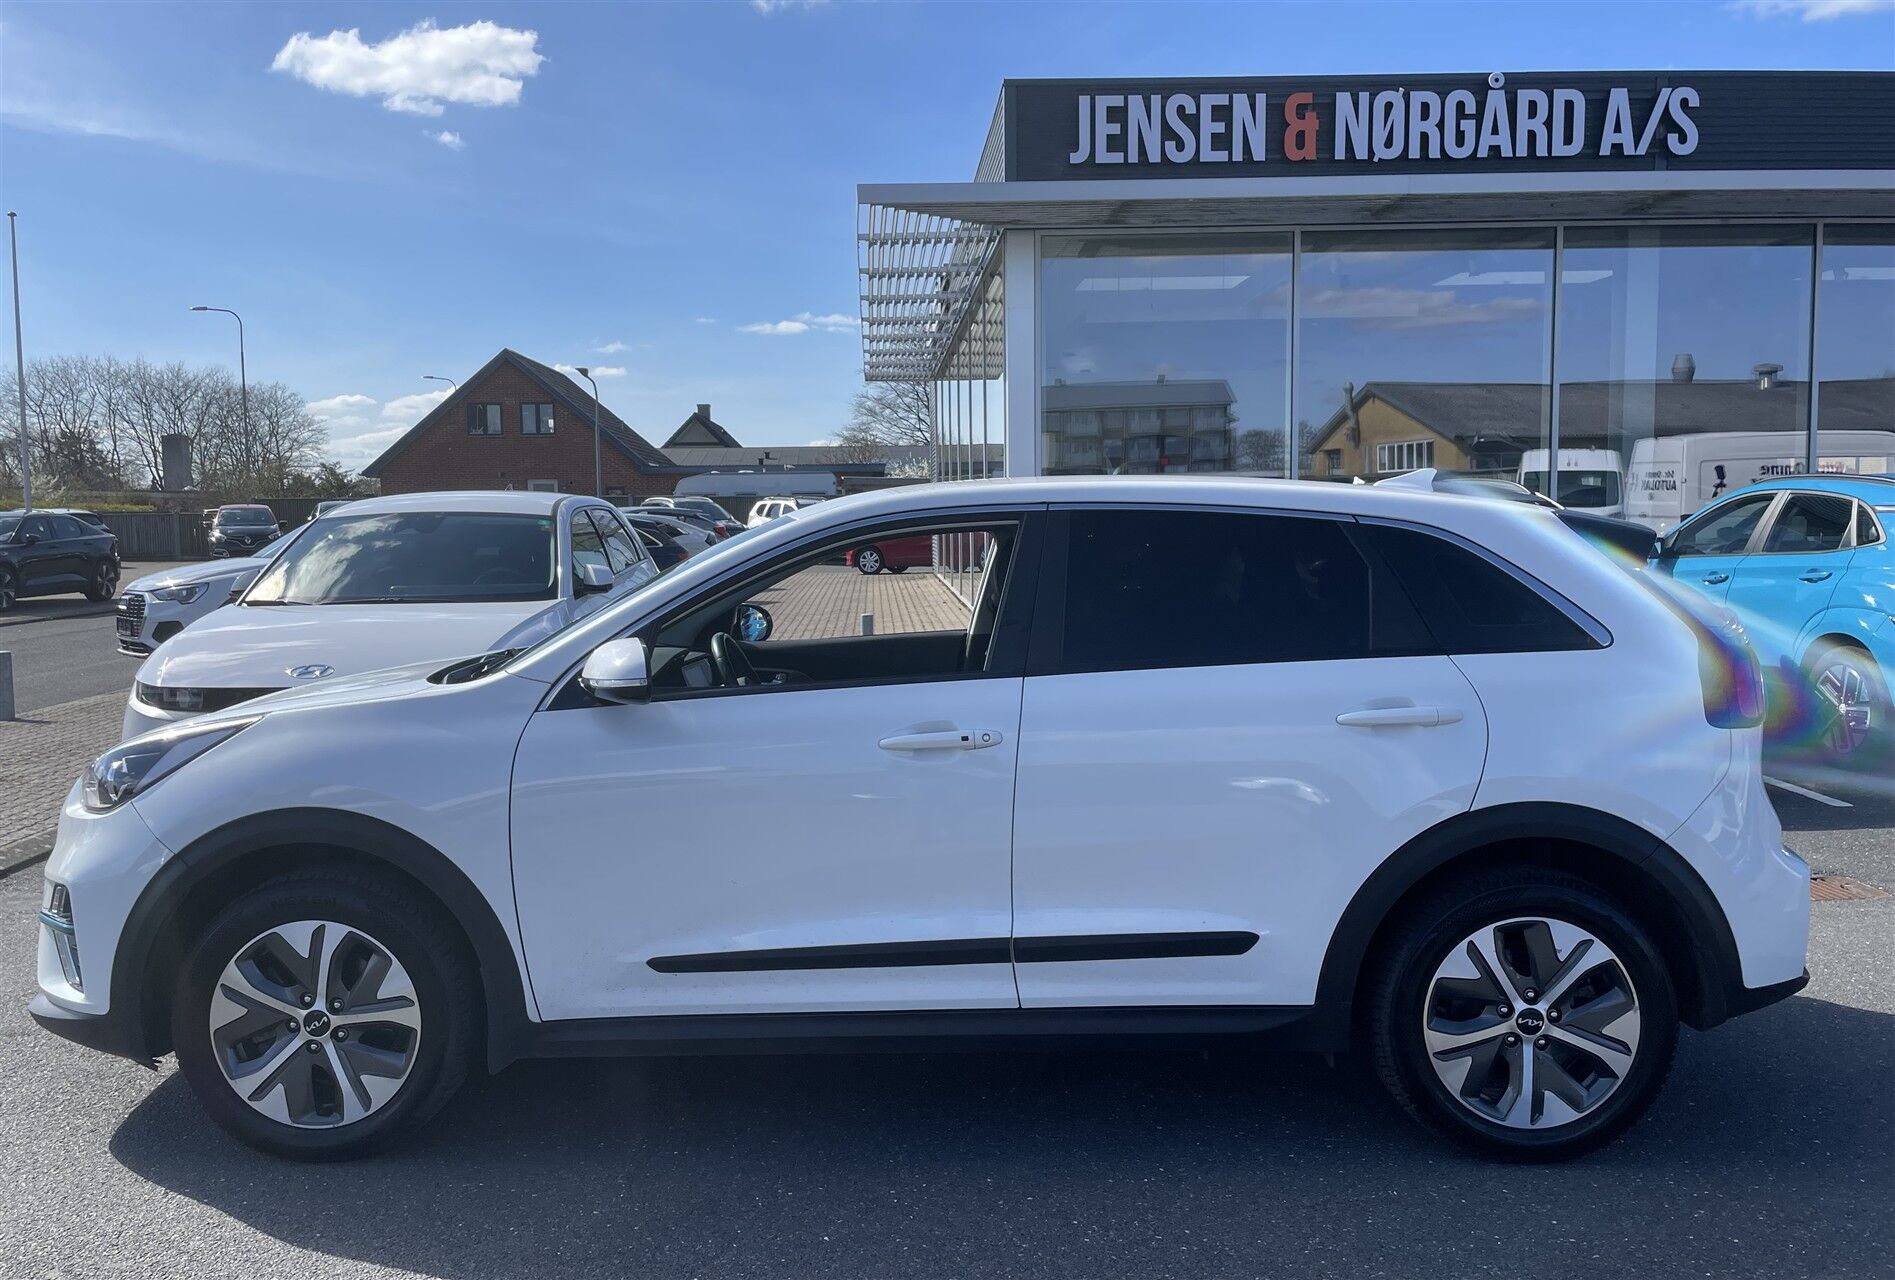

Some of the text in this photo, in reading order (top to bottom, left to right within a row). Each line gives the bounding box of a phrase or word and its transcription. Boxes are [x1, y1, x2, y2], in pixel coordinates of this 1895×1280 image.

[1069, 71, 1700, 164] JENSEN & NØRGÅRD A/S
